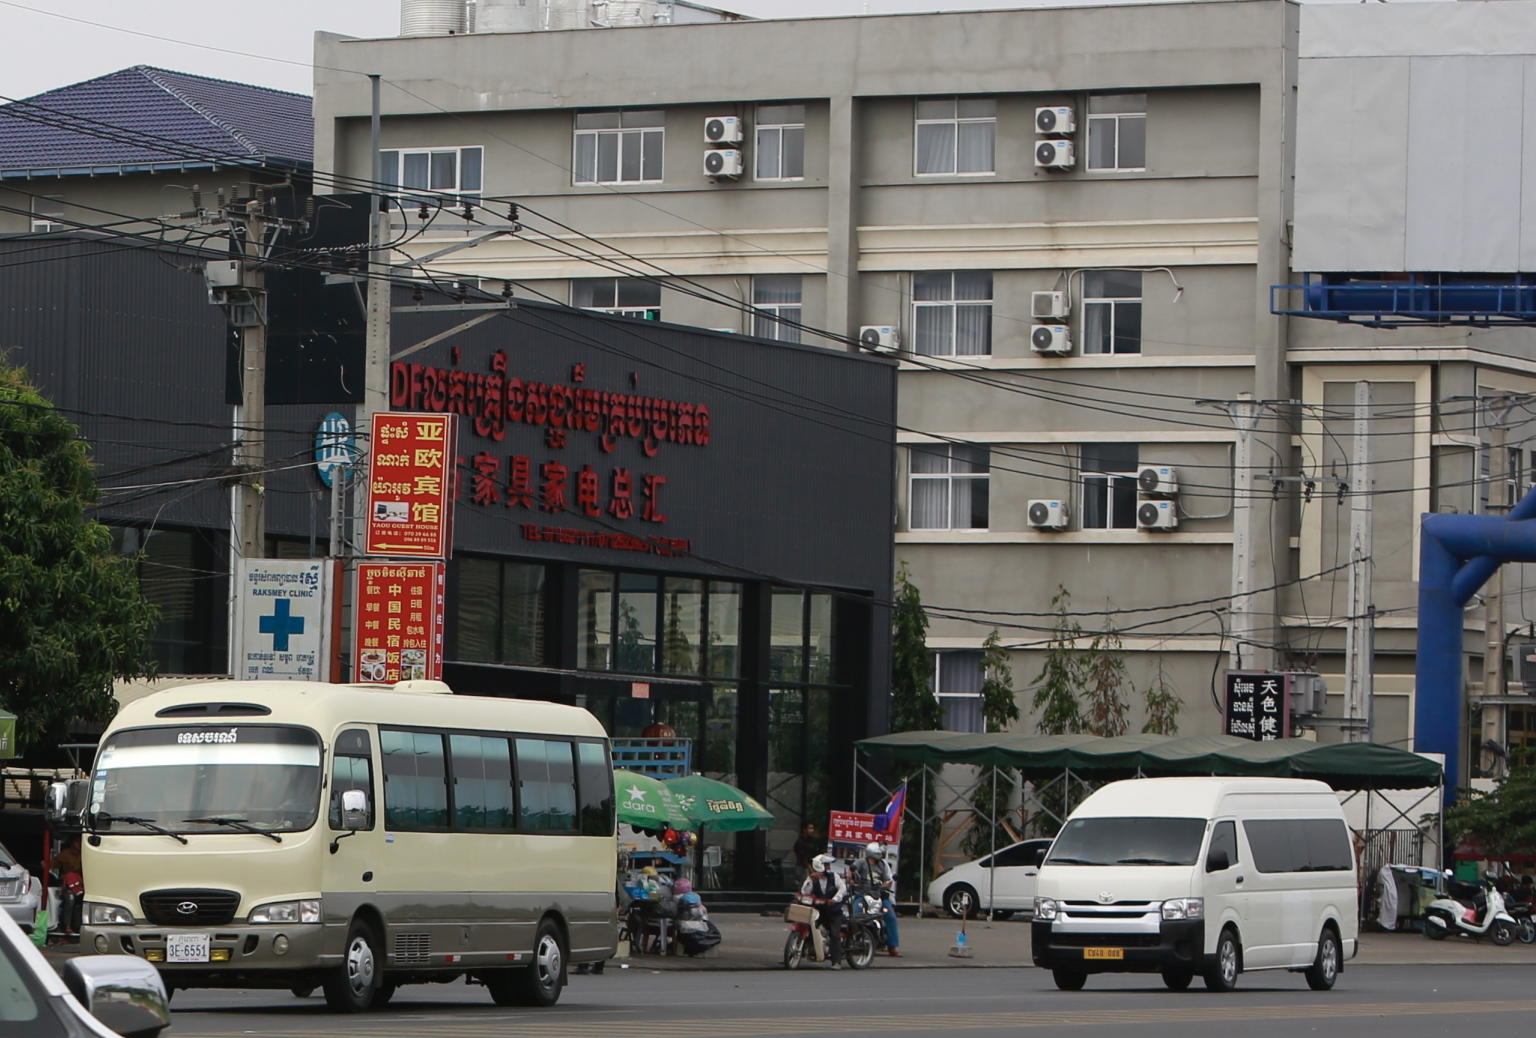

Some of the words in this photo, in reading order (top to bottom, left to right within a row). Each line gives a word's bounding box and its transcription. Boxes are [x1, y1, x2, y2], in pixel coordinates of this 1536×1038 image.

[411, 421, 444, 523] 亚欧宾馆
[454, 450, 669, 523] 家具家电总汇
[253, 589, 286, 597] RAKSMEY
[387, 584, 402, 681] 中国民宿饭店
[622, 800, 656, 814] dara
[169, 944, 207, 957] 3E-6551
